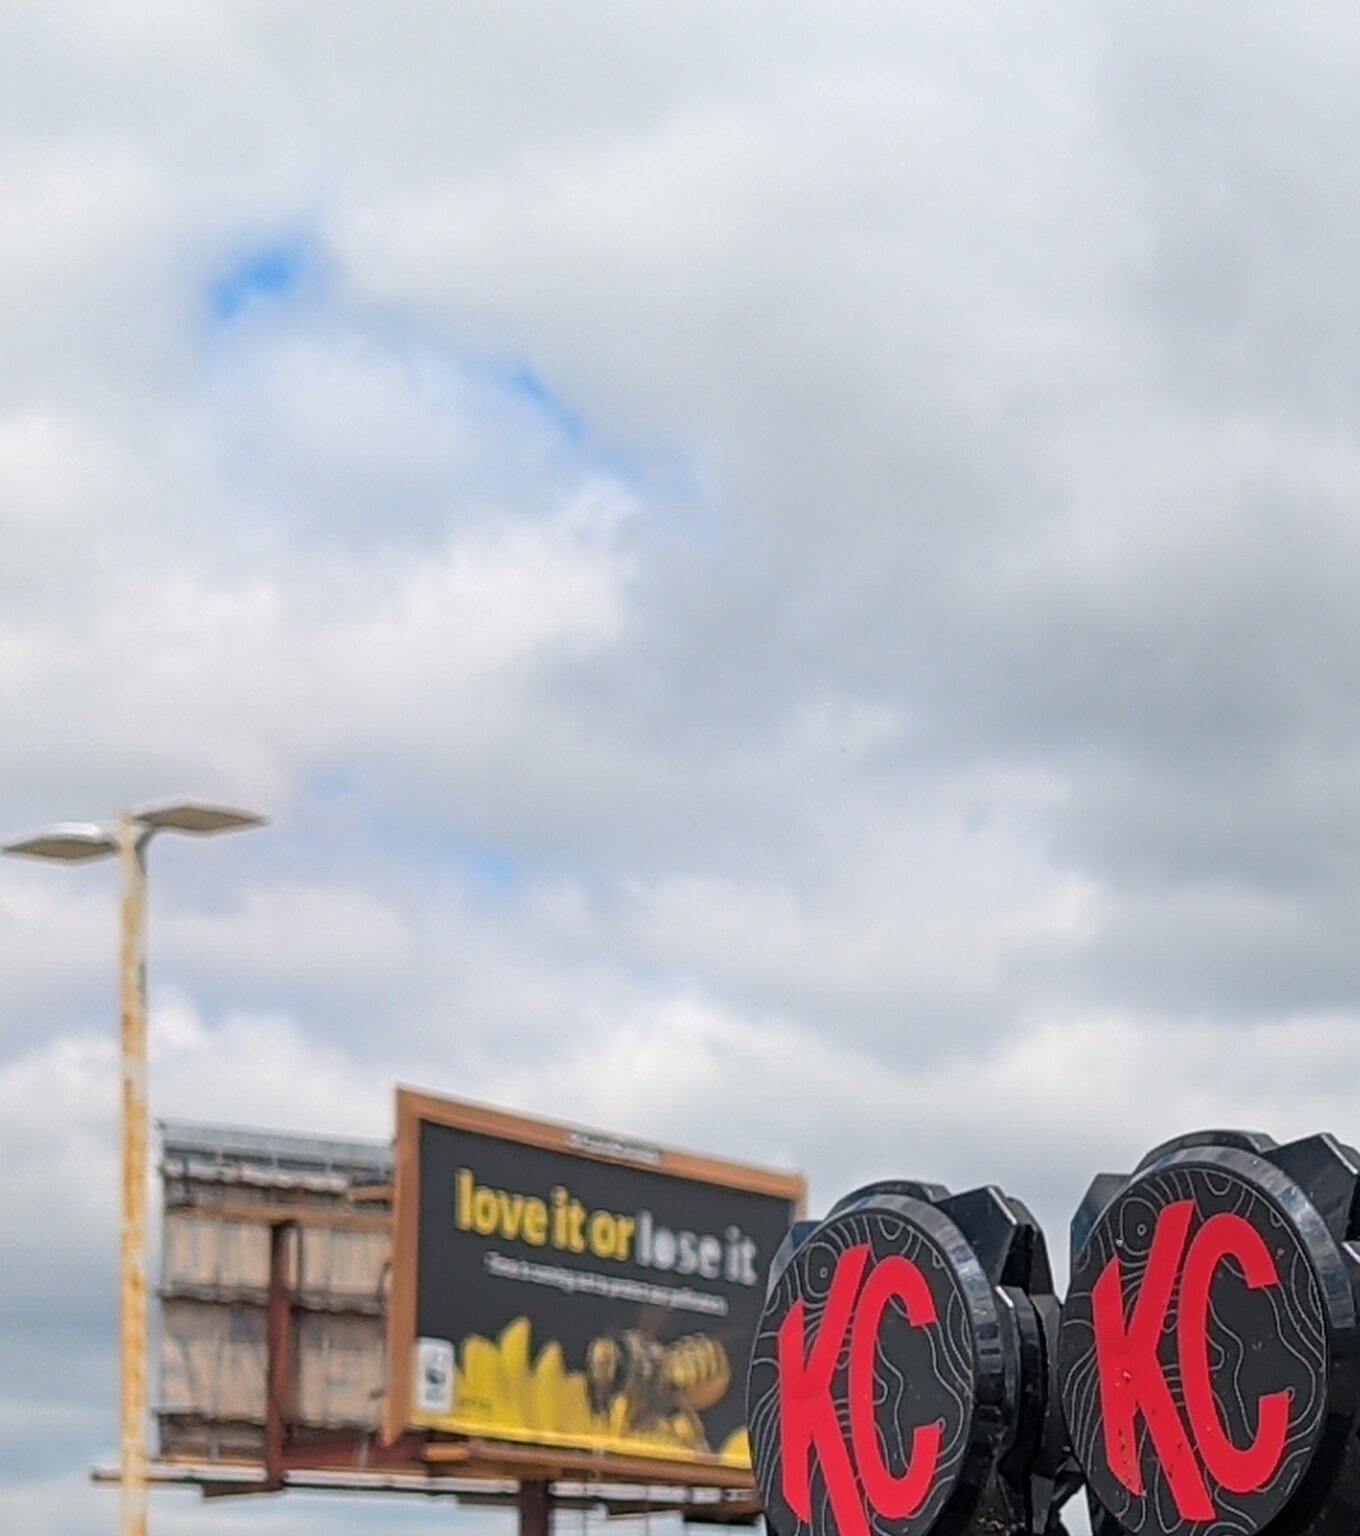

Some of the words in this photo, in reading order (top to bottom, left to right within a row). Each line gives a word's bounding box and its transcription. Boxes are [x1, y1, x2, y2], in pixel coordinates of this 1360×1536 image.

[455, 1167, 548, 1246] love
[552, 1185, 587, 1254] it
[589, 1210, 635, 1262] or
[635, 1208, 721, 1279] lose
[724, 1224, 758, 1287] it
[1092, 1201, 1289, 1521] KC
